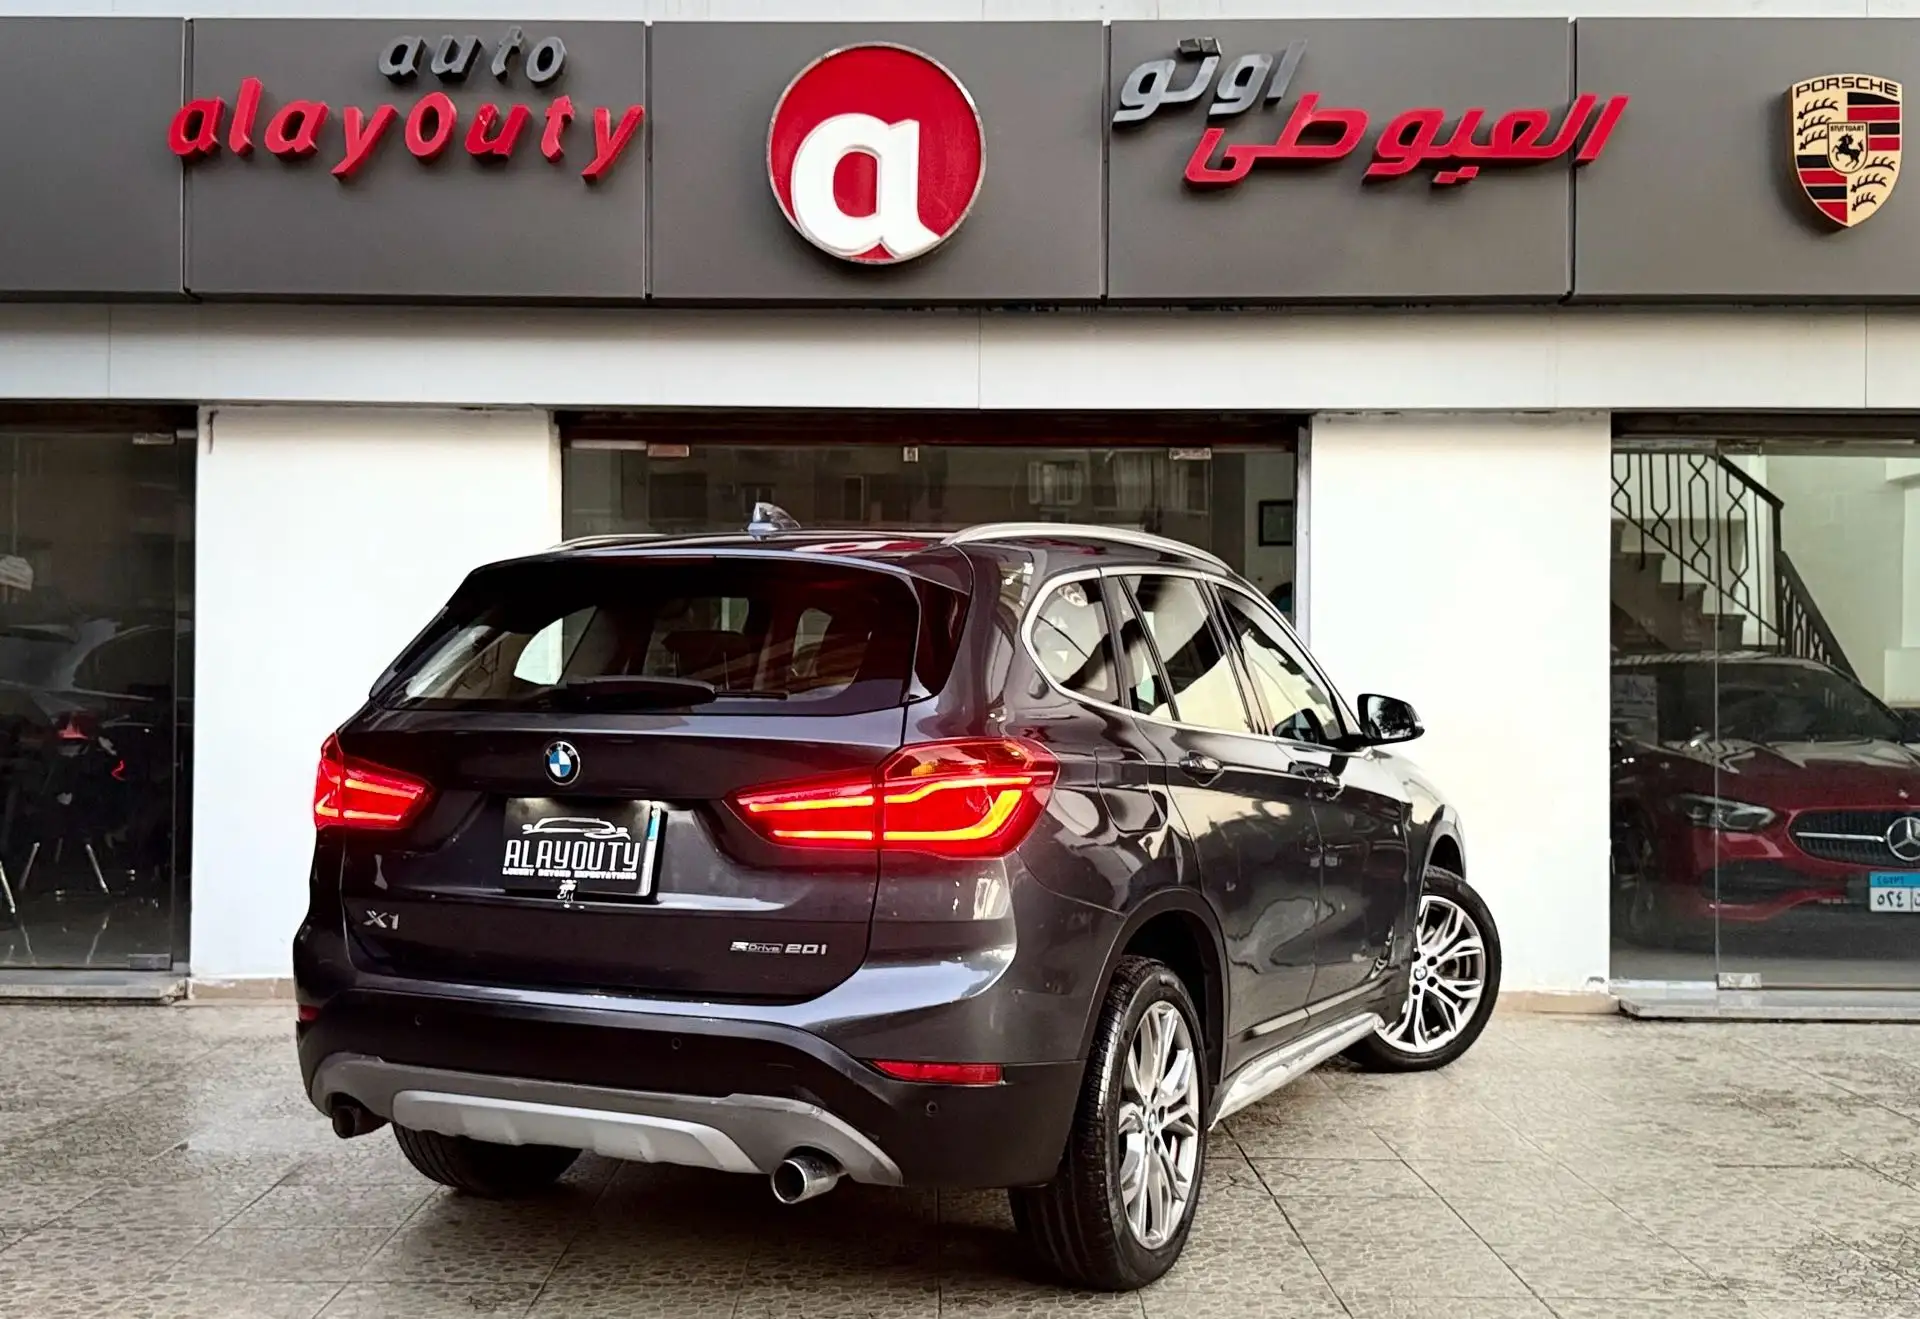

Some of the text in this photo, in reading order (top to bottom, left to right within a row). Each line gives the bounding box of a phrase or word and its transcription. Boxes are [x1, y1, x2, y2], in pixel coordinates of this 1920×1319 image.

[378, 26, 567, 84] auto
[1112, 36, 1308, 124] اوتو
[1796, 76, 1899, 98] PORSCHE
[790, 112, 941, 260] a
[504, 839, 641, 872] ALAYOUTY
[362, 909, 399, 930] X1
